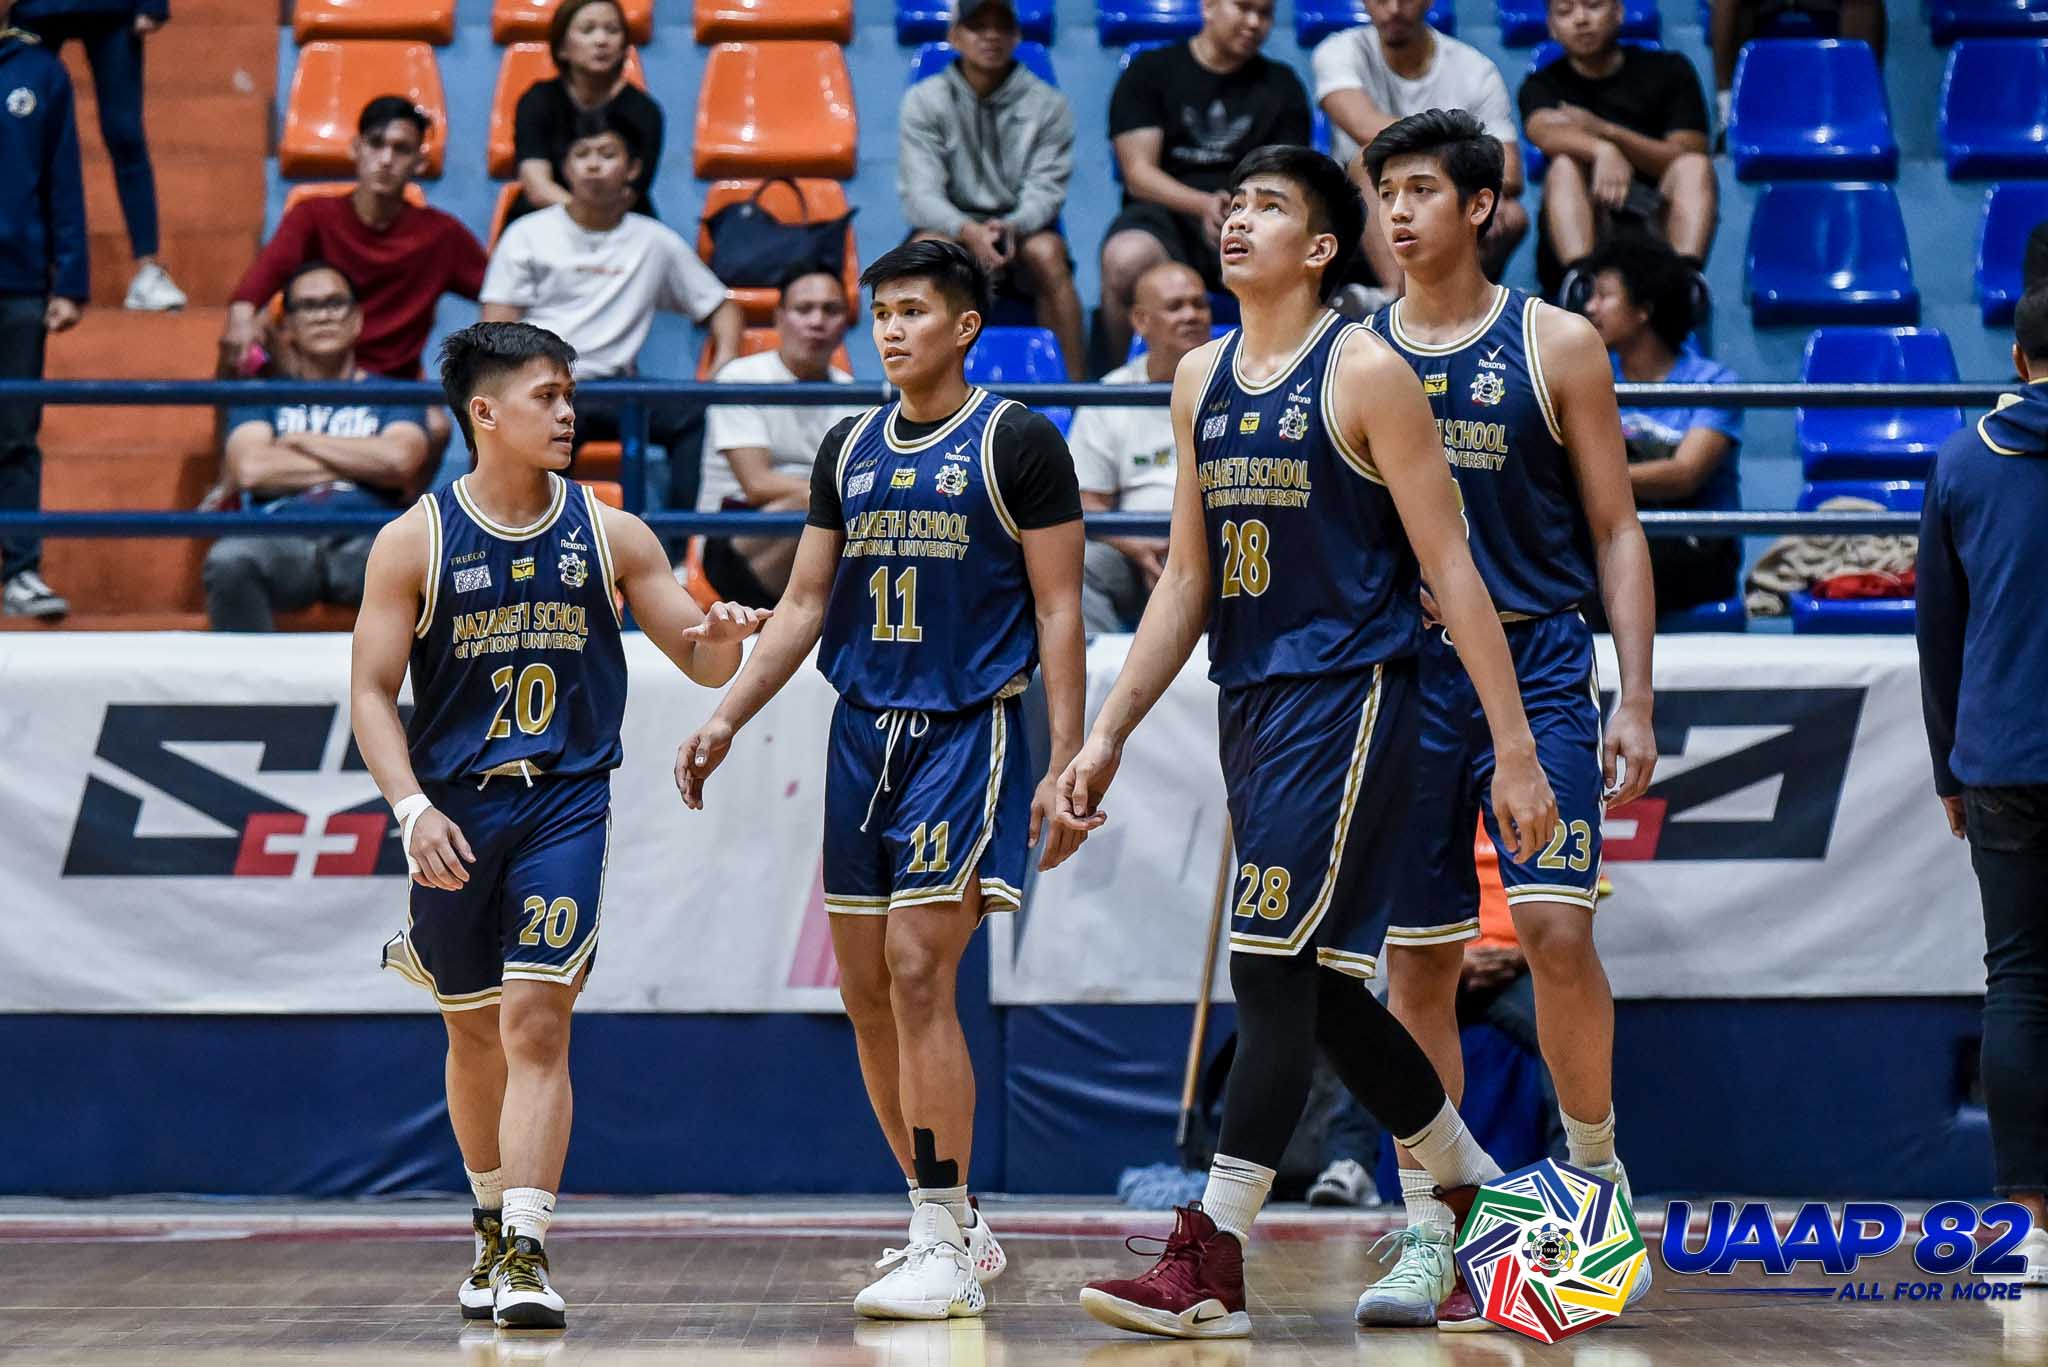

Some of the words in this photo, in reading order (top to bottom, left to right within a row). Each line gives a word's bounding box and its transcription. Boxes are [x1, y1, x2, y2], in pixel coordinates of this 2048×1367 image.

[1478, 359, 1507, 371] Rexona
[1445, 418, 1508, 453] SCHOOL
[1249, 457, 1312, 490] SCHOOL
[1444, 447, 1506, 471] NIVERSITY
[909, 510, 969, 543] SCHOOL
[560, 539, 588, 551] Rexona
[898, 539, 968, 561] UNIVERSITY
[1221, 519, 1270, 599] 28
[869, 566, 923, 643] 11
[455, 642, 468, 660] of
[485, 663, 557, 740] 20
[907, 820, 951, 873] 11
[1537, 818, 1592, 873] 23
[1235, 862, 1291, 920] 28
[518, 895, 578, 949] 20
